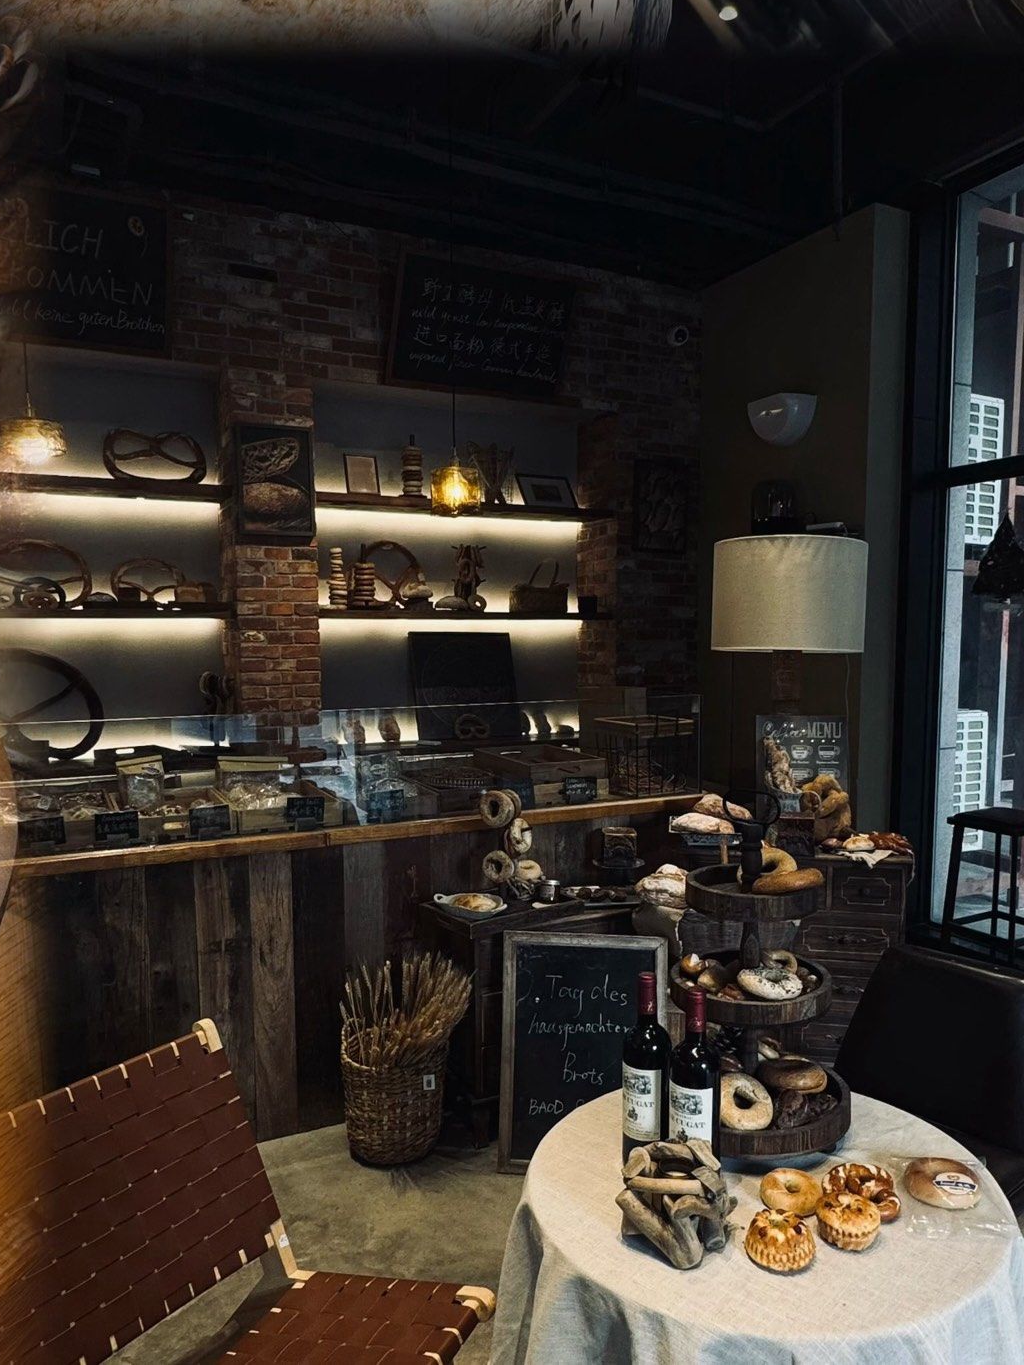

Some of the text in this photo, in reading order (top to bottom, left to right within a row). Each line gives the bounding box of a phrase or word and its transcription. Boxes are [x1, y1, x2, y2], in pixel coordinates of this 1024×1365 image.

[806, 721, 843, 739] MENU
[544, 973, 629, 1019] Tag des
[561, 1051, 605, 1086] Brots
[528, 1097, 564, 1115] BAOD
